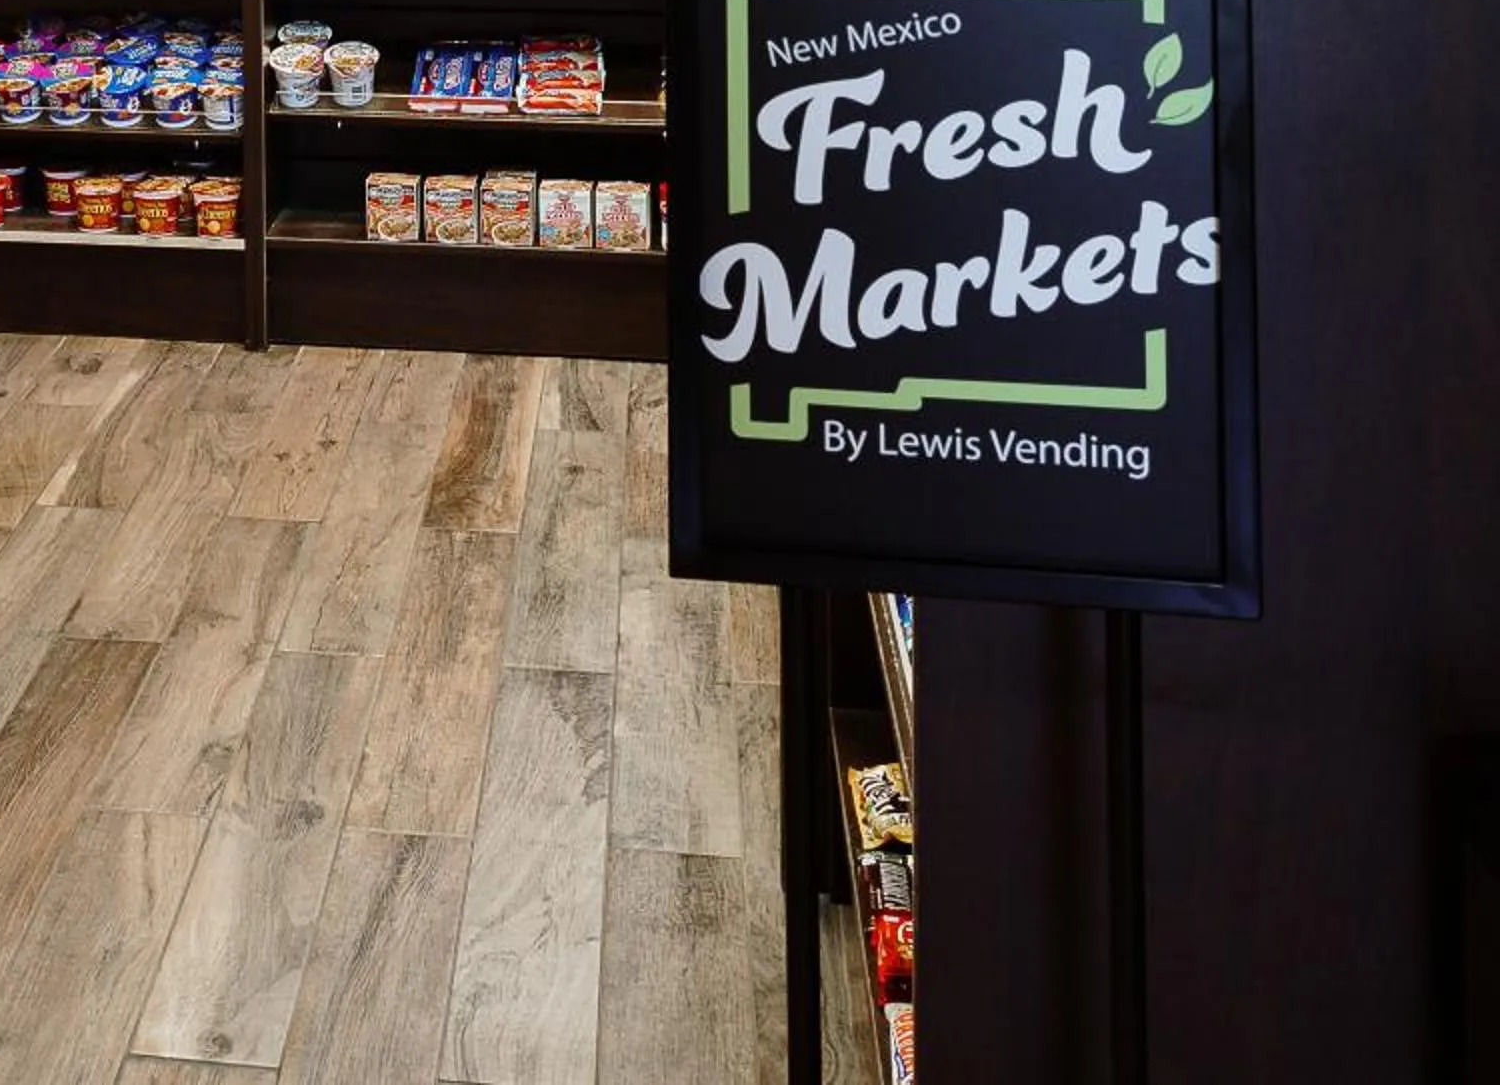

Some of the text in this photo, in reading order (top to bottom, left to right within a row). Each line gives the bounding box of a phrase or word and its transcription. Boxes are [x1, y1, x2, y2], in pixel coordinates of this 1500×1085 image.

[766, 12, 962, 68] New Mexico
[757, 48, 1153, 205] Fresh
[699, 200, 1219, 363] Markets
[824, 420, 1150, 480] By Lewis Vending
